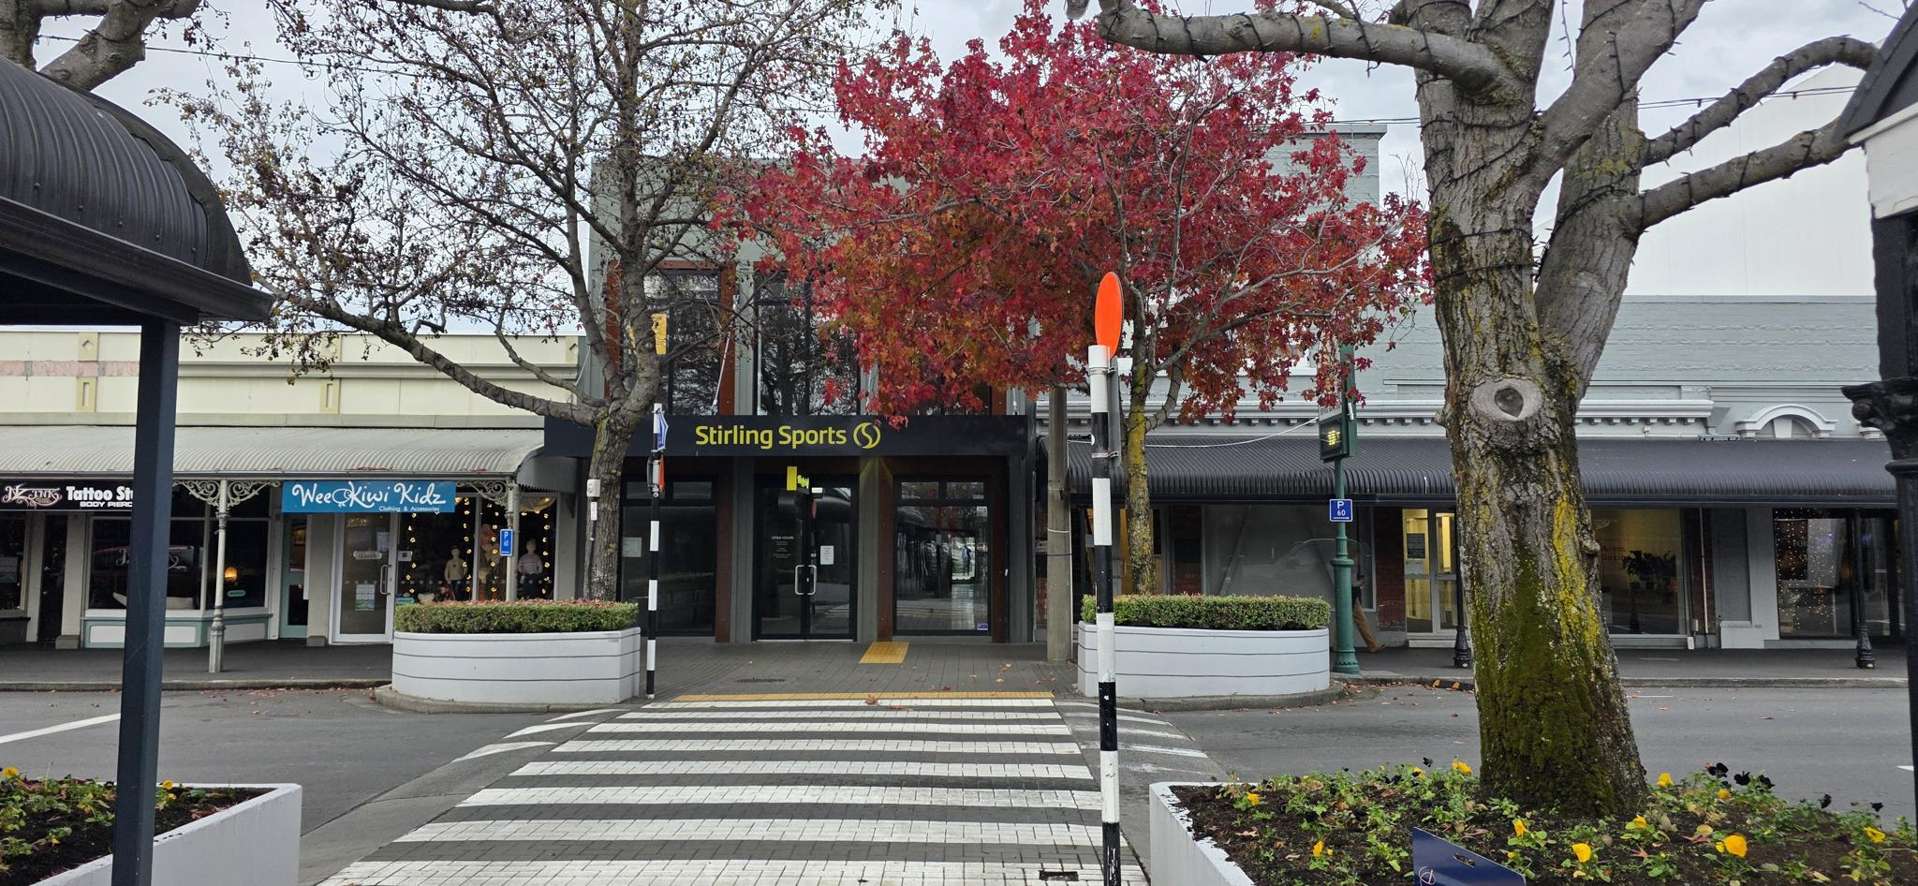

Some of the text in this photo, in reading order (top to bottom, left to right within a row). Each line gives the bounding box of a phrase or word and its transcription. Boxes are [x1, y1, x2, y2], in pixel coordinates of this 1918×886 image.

[695, 425, 847, 449] Stirling Sports
[66, 486, 113, 501] Tattoo
[292, 481, 447, 508] Wee Kiwi Kidz
[1337, 500, 1345, 509] P
[1337, 509, 1346, 517] 60
